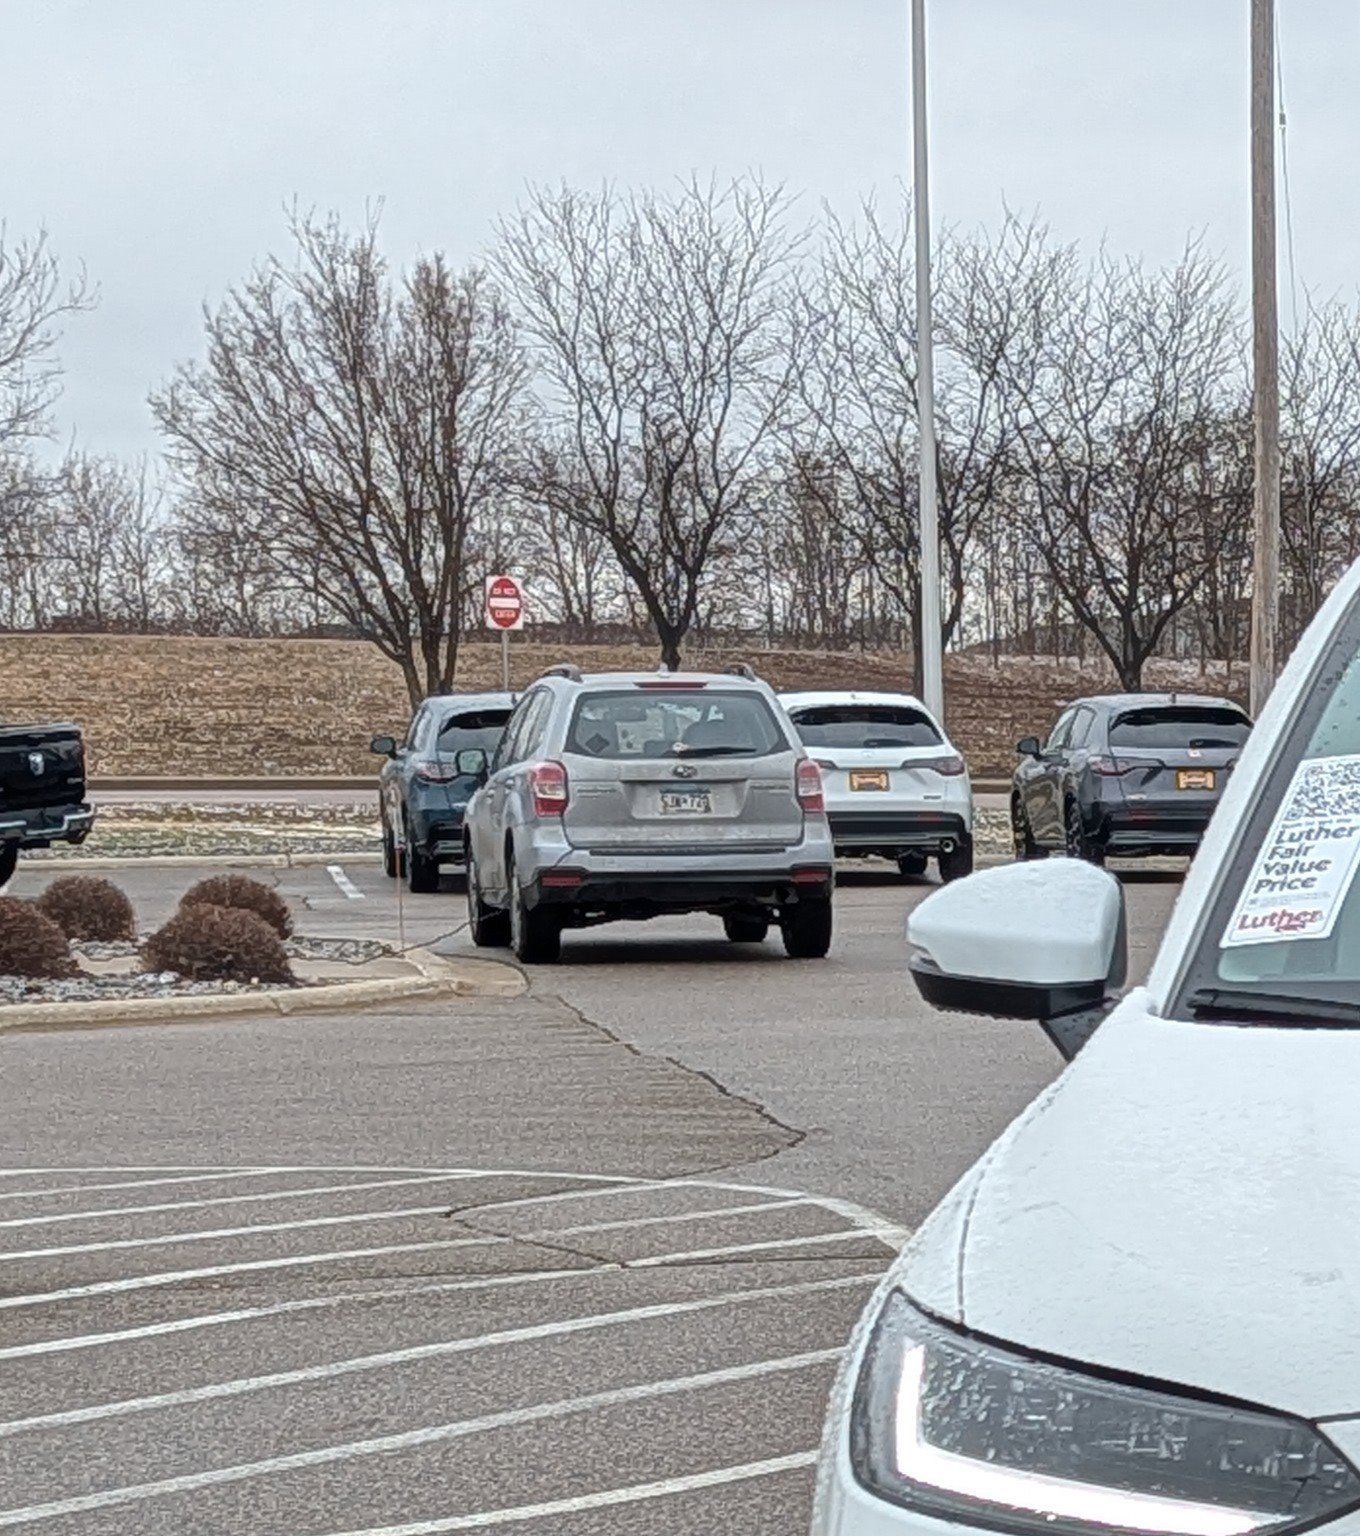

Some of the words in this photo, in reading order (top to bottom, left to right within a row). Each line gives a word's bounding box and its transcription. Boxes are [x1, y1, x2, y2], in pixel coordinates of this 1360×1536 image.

[1275, 824, 1360, 845] Luther
[1267, 843, 1315, 861] Fair
[1263, 858, 1331, 877] Value
[1253, 876, 1317, 894] Price
[1238, 909, 1324, 931] Luther
